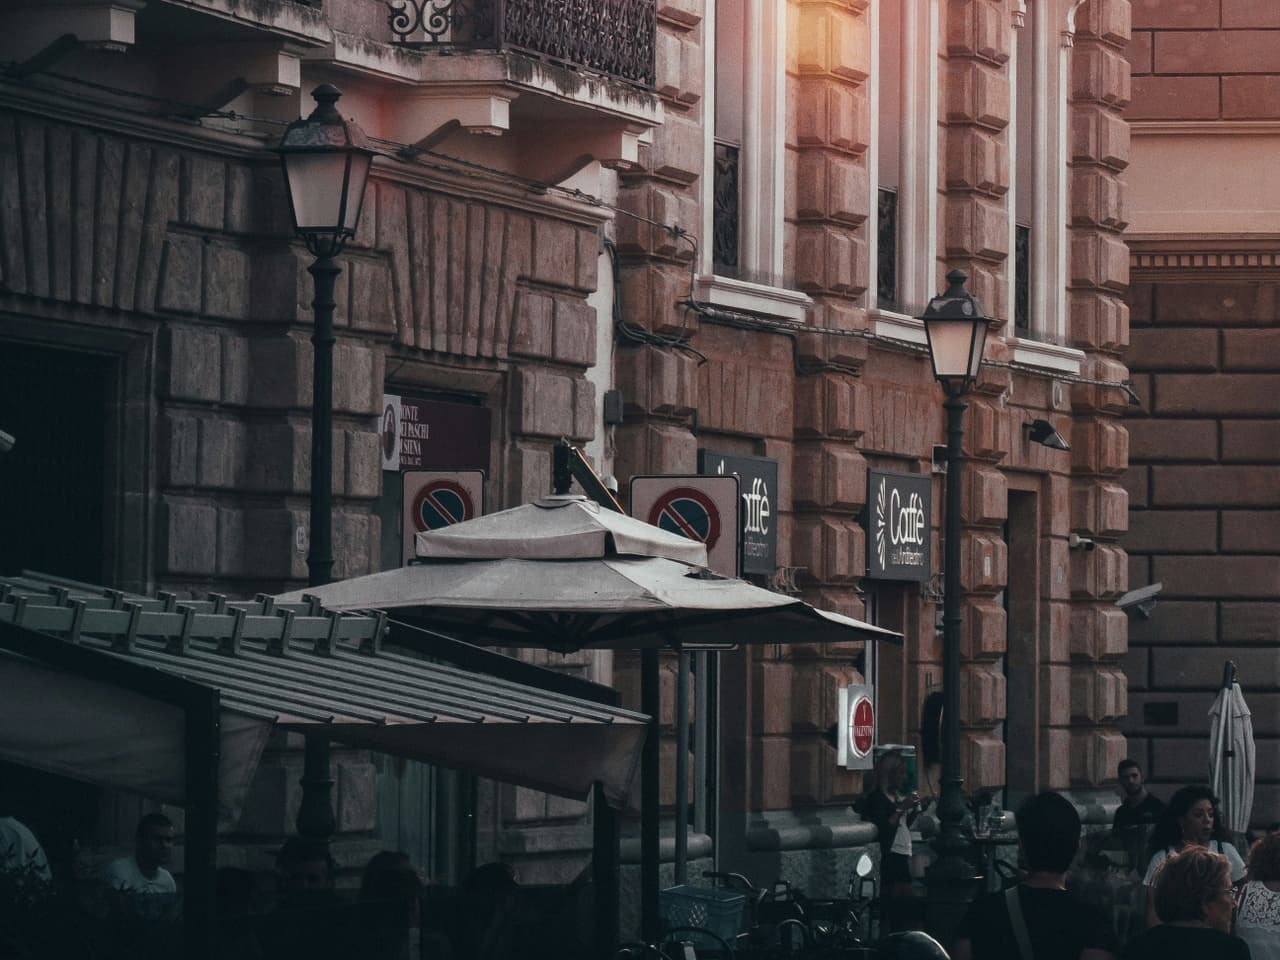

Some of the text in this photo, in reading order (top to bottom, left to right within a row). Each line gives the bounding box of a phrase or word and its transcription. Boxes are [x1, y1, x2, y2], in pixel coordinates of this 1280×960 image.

[404, 439, 421, 456] SIENA
[408, 422, 429, 439] PASCHI
[742, 477, 770, 536] ffè
[890, 488, 925, 545] Caffè
